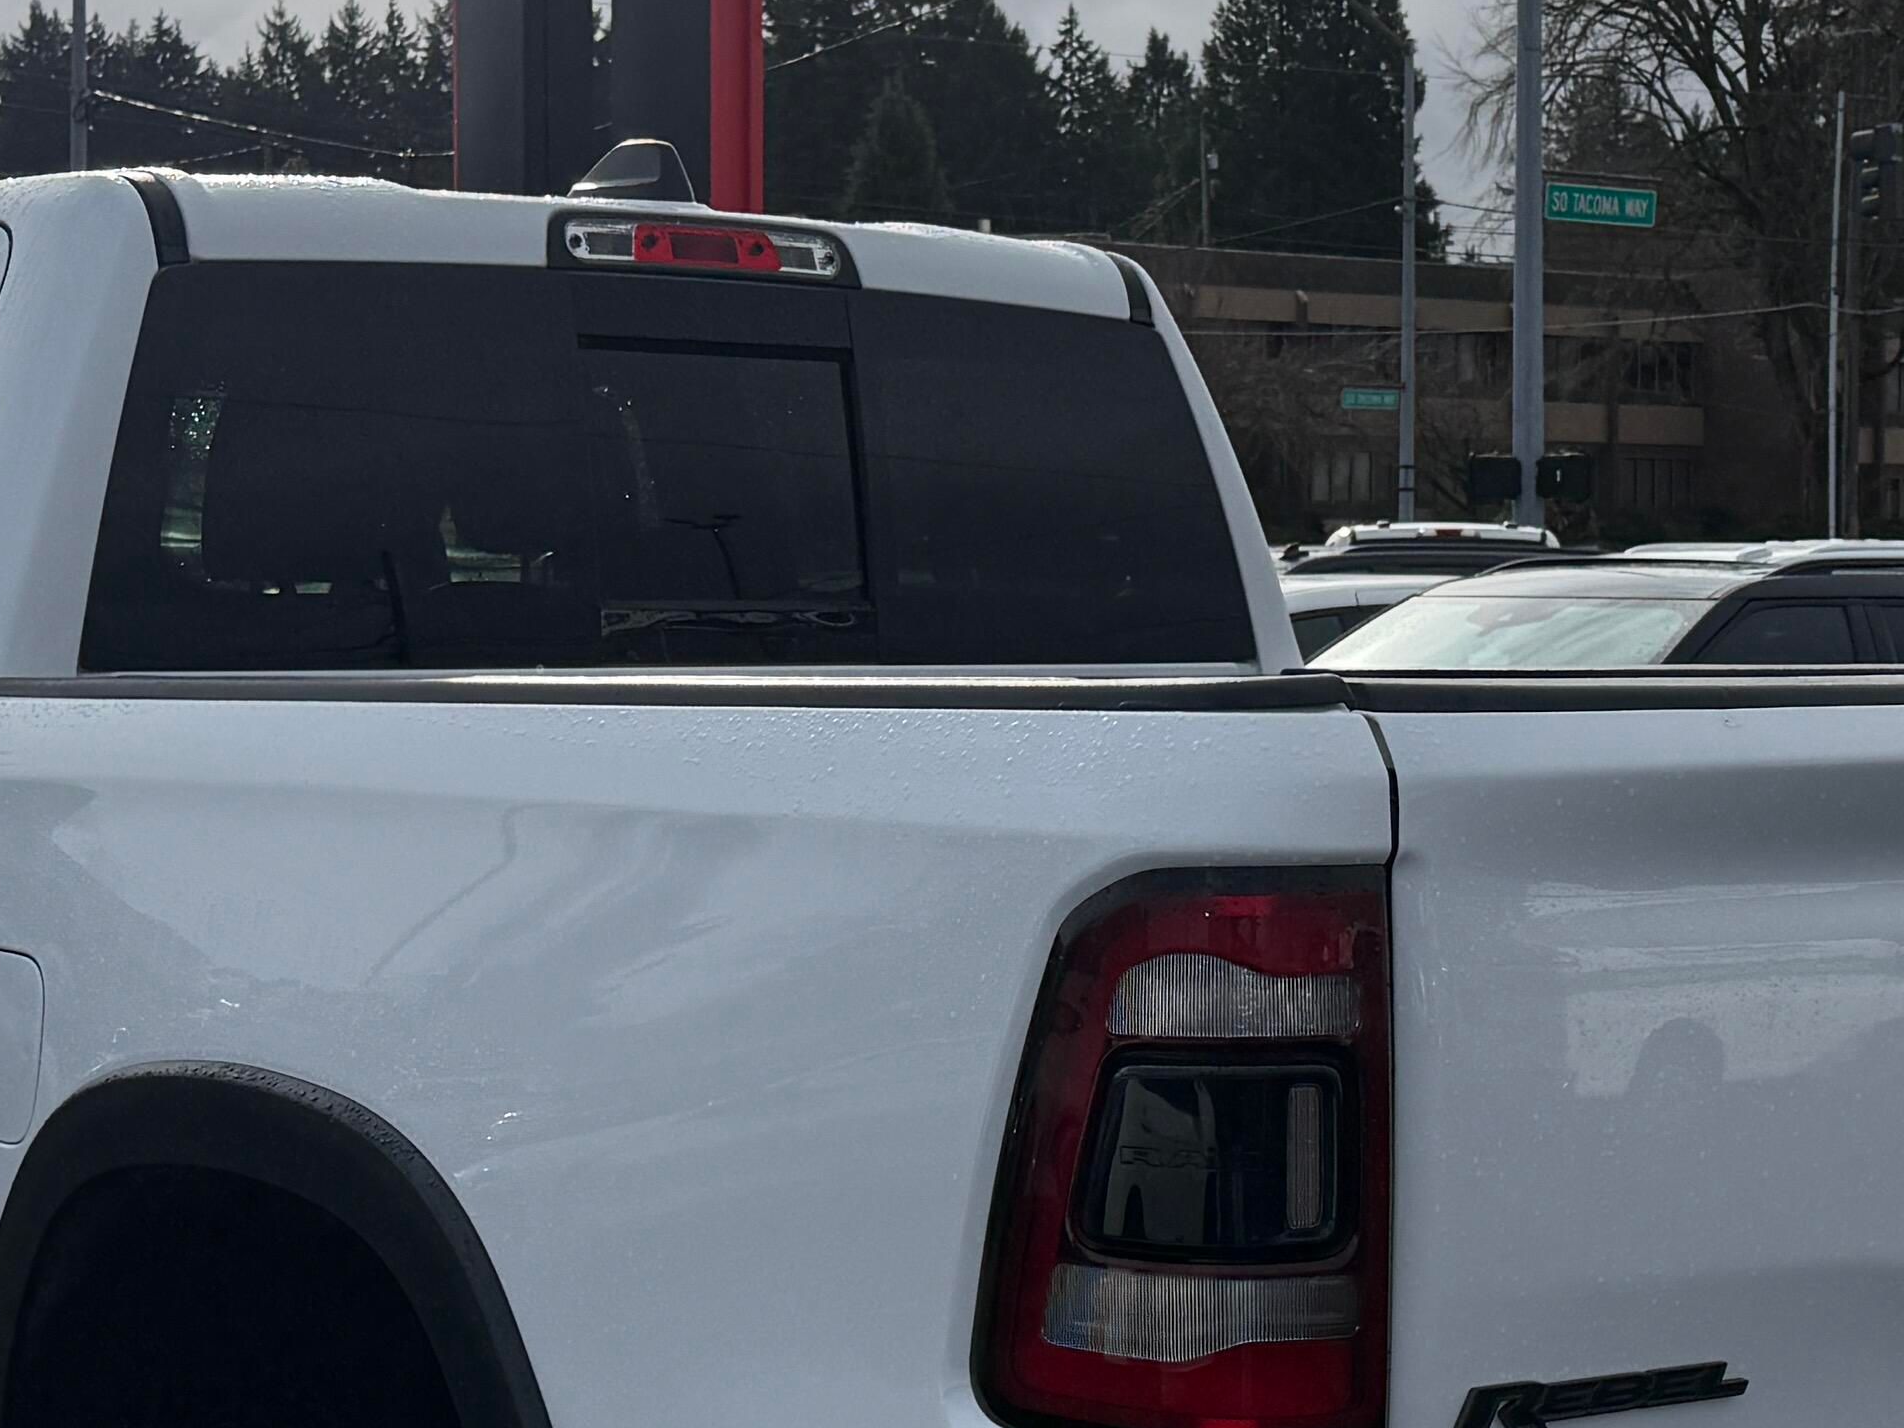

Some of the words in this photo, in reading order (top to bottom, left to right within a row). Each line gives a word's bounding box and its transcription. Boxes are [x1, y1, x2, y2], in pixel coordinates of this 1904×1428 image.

[1551, 191, 1569, 213] SO
[1573, 193, 1621, 217] TACOMA
[1624, 198, 1649, 218] WAY
